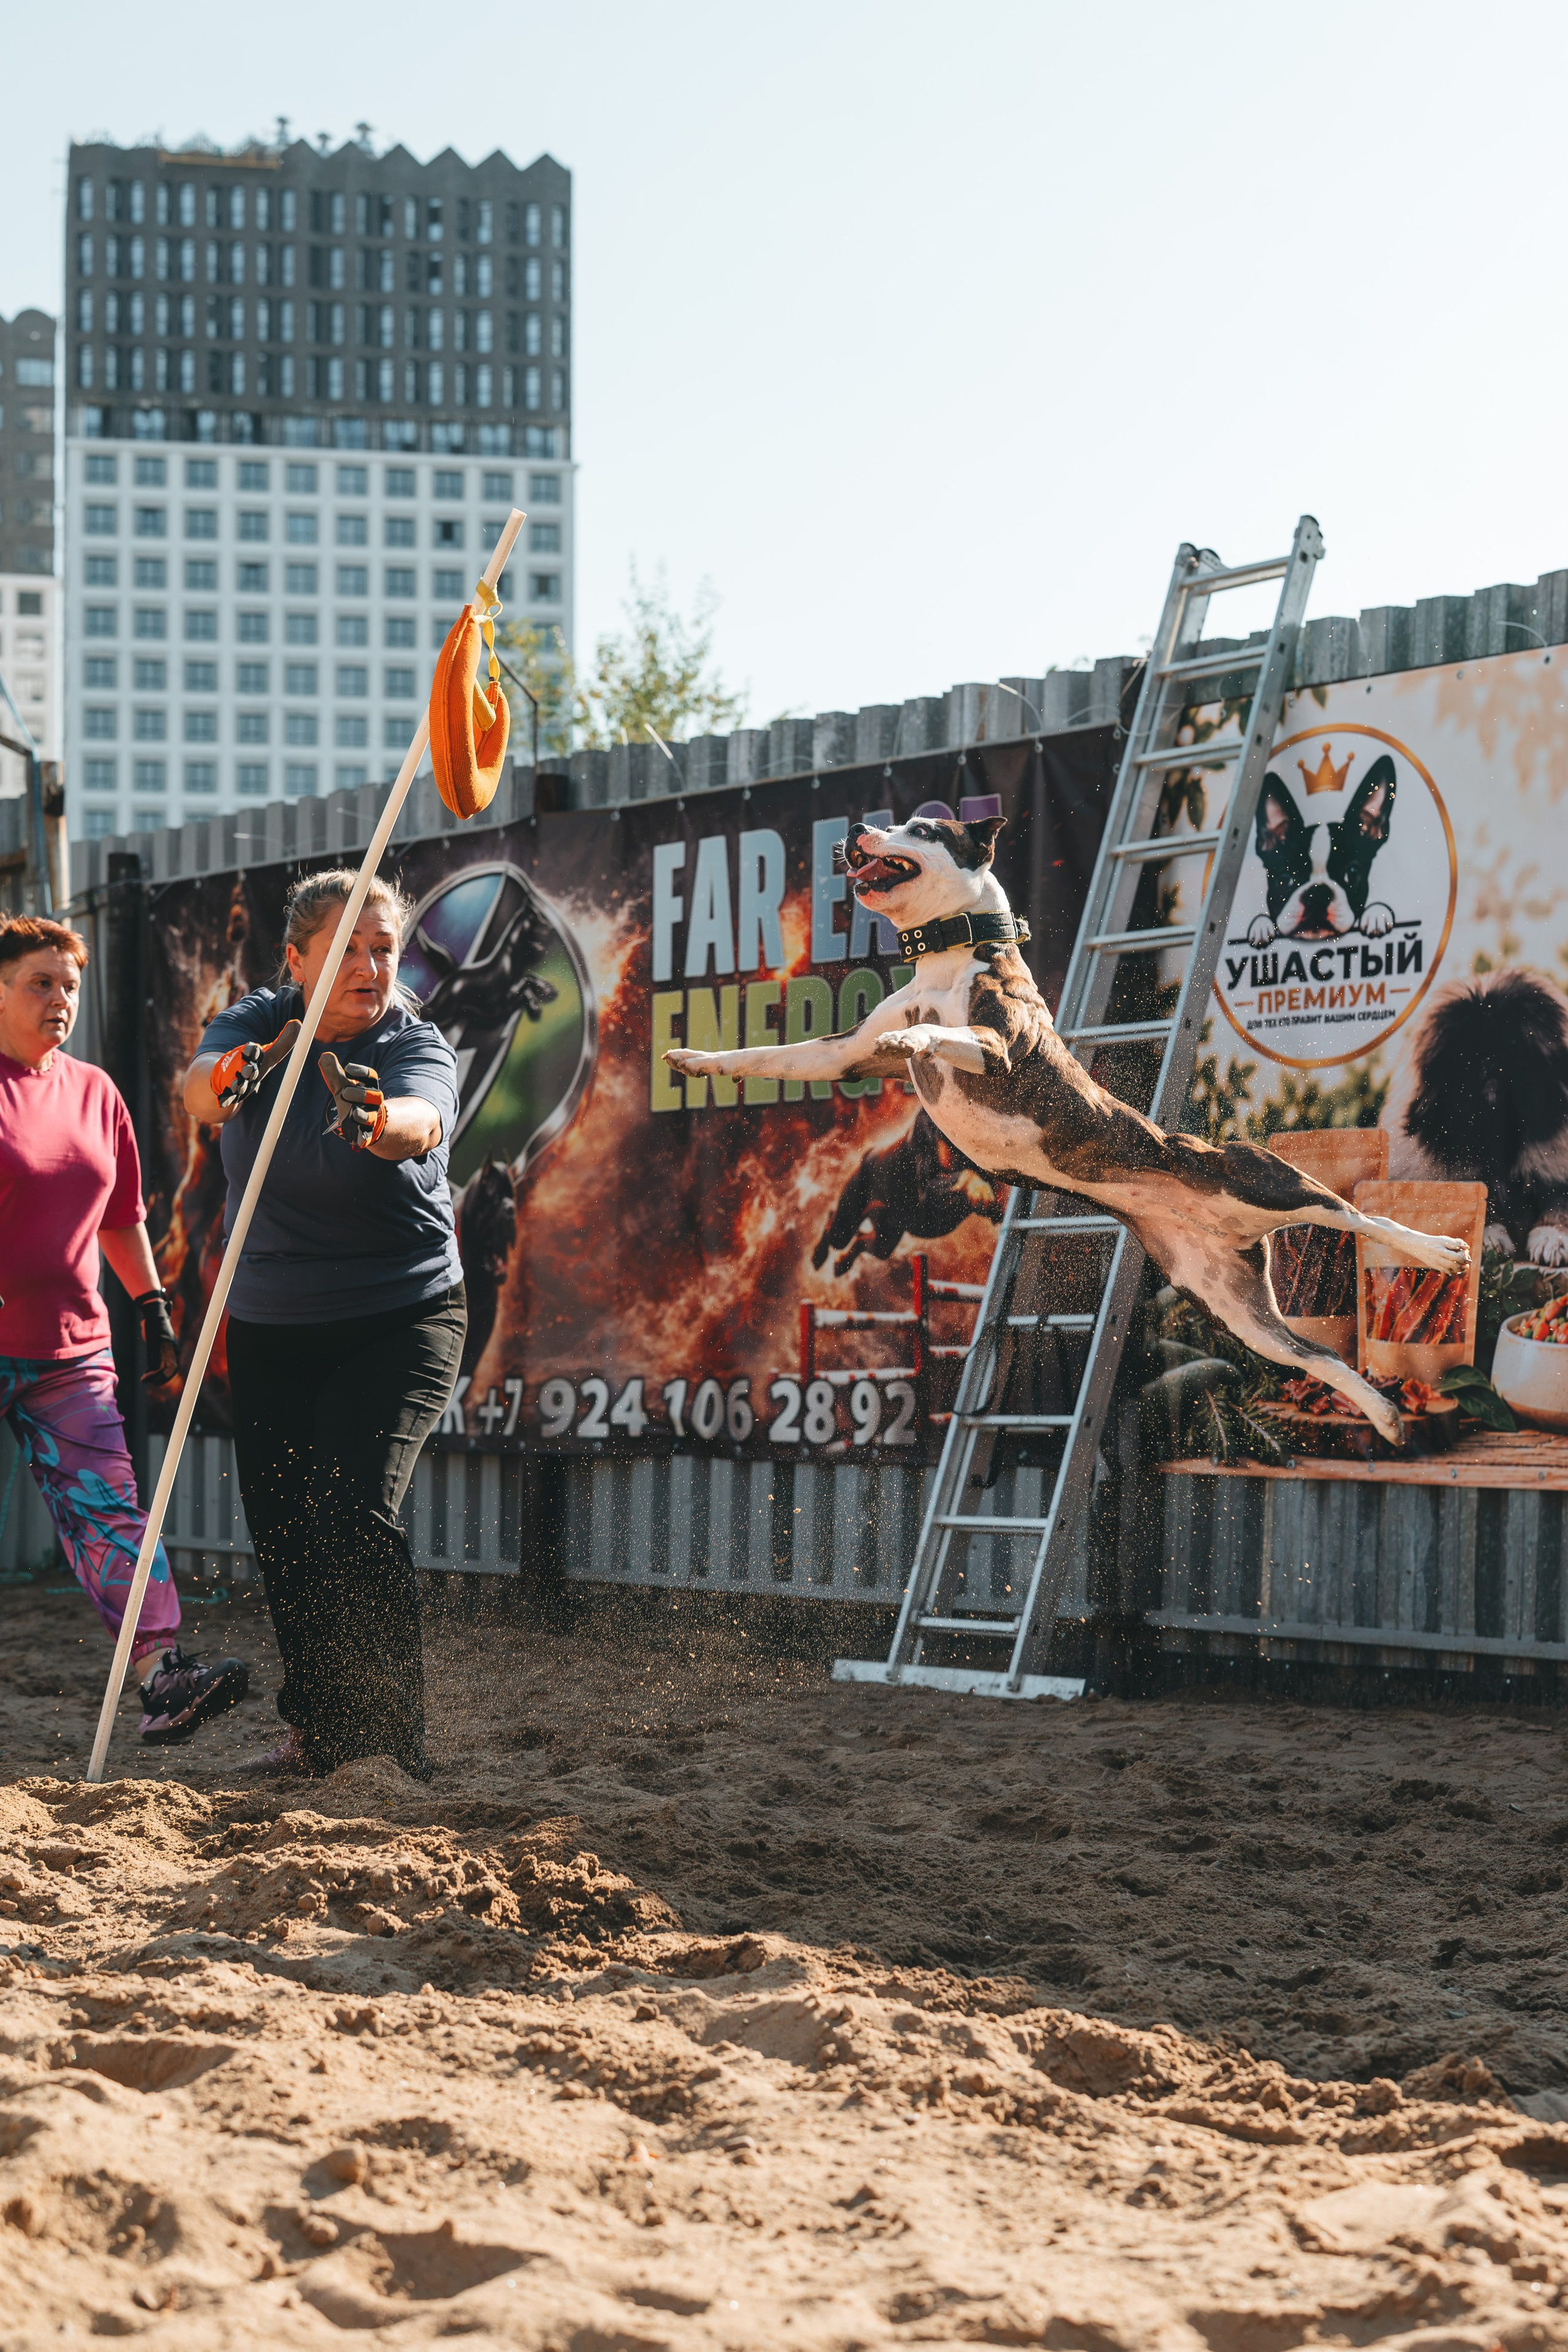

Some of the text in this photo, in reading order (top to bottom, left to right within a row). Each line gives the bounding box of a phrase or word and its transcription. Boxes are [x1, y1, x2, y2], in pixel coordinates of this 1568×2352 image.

[652, 828, 786, 982] FAR
[1226, 932, 1422, 990] УШАСТЫЙ
[1258, 982, 1385, 1014] ПРЕМИУМ
[478, 1378, 524, 1436] +7
[538, 1376, 649, 1438] 924
[663, 1378, 754, 1441] 106
[768, 1379, 836, 1444] 28
[850, 1379, 916, 1446] 92
